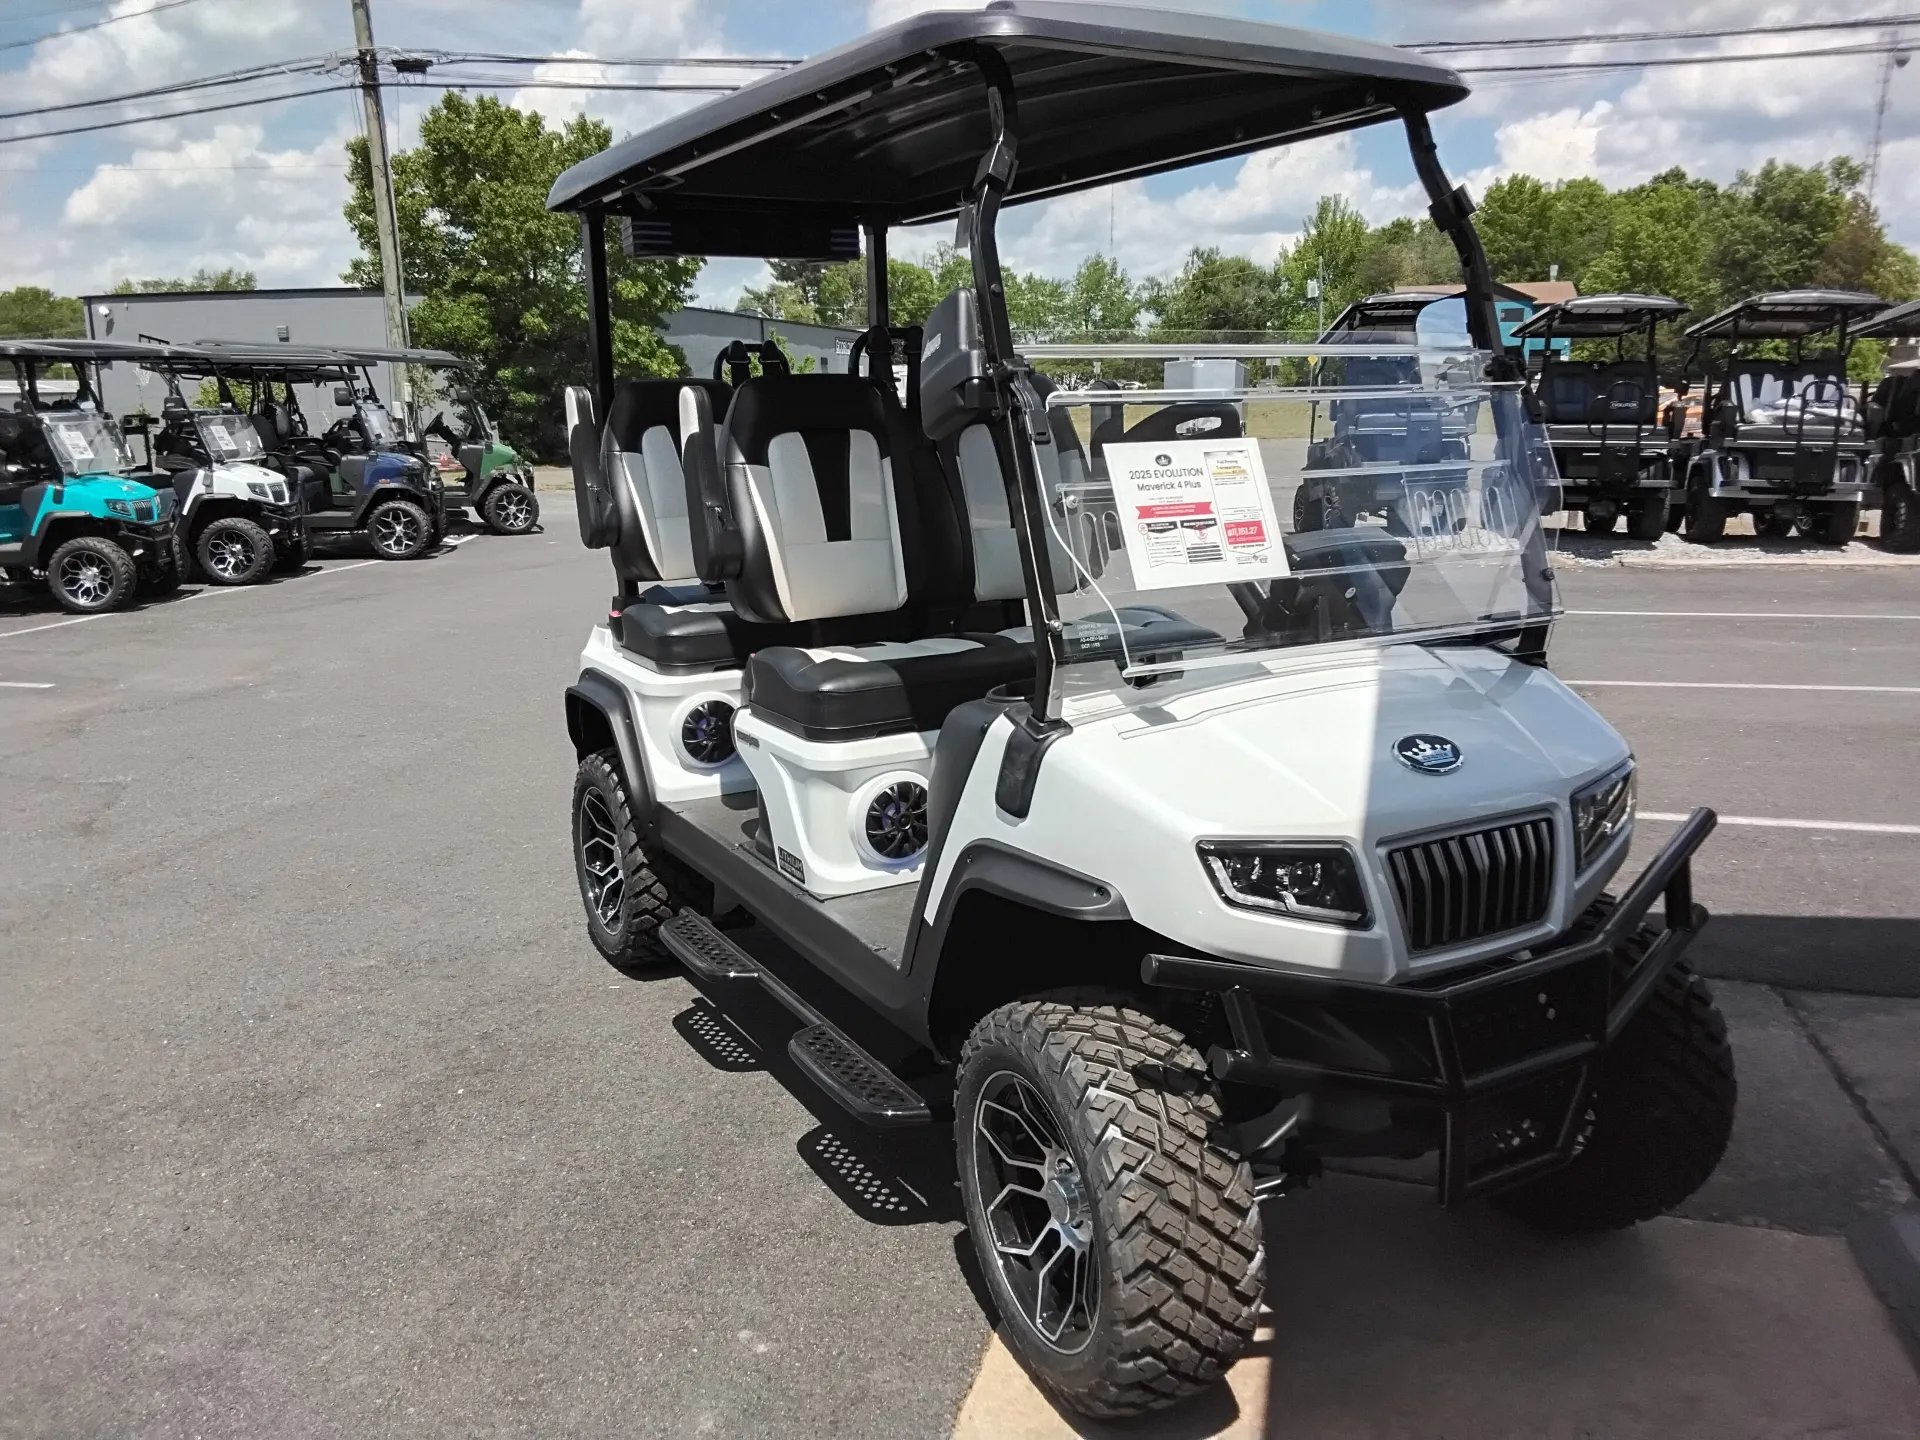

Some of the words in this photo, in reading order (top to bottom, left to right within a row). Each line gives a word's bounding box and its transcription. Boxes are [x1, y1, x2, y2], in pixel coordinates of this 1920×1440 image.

[1128, 469, 1152, 480] 2025
[1153, 467, 1204, 478] EVOLUTION
[1137, 482, 1176, 491] Maverick
[1184, 480, 1201, 488] Plus
